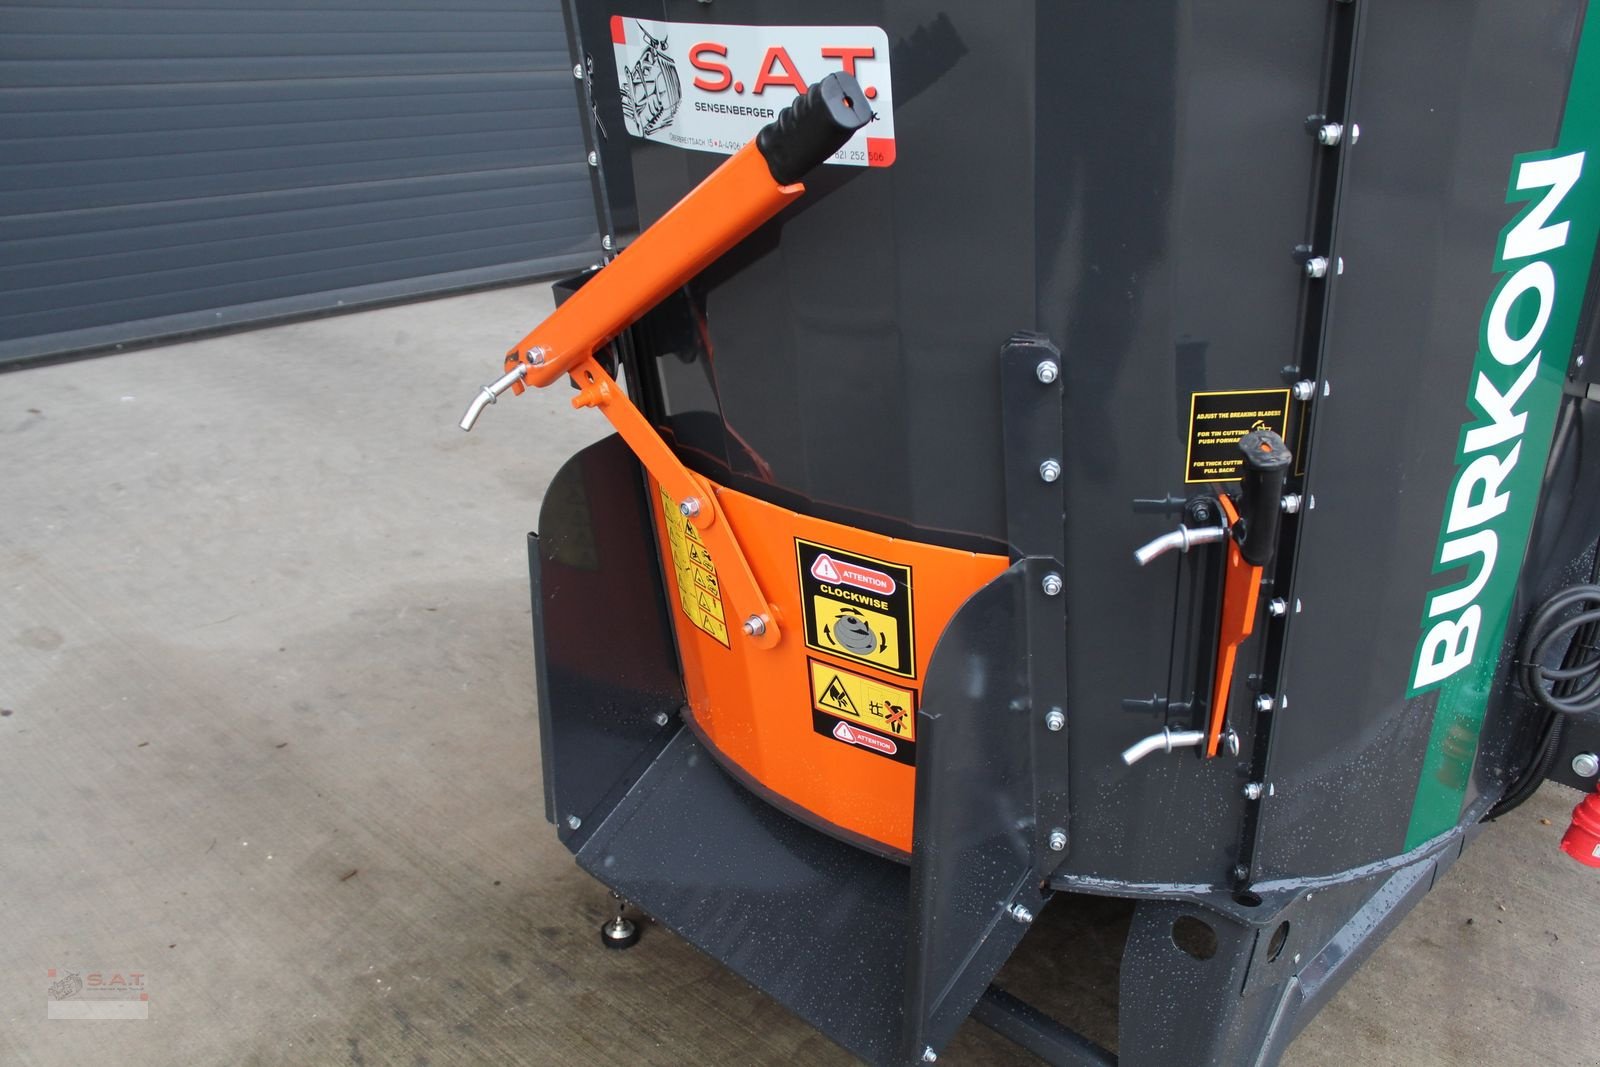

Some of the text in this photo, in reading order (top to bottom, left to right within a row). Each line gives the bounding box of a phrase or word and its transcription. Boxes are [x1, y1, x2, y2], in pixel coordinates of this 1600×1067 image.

[688, 42, 877, 99] S.AT.
[694, 102, 775, 118] SENSENBERGER
[850, 150, 865, 161] 252
[868, 151, 885, 162] 506
[1413, 151, 1586, 689] BURKON
[843, 570, 887, 588] ATTENTION
[820, 584, 889, 610] CLOCKWISE
[857, 734, 891, 750] ATTENTION
